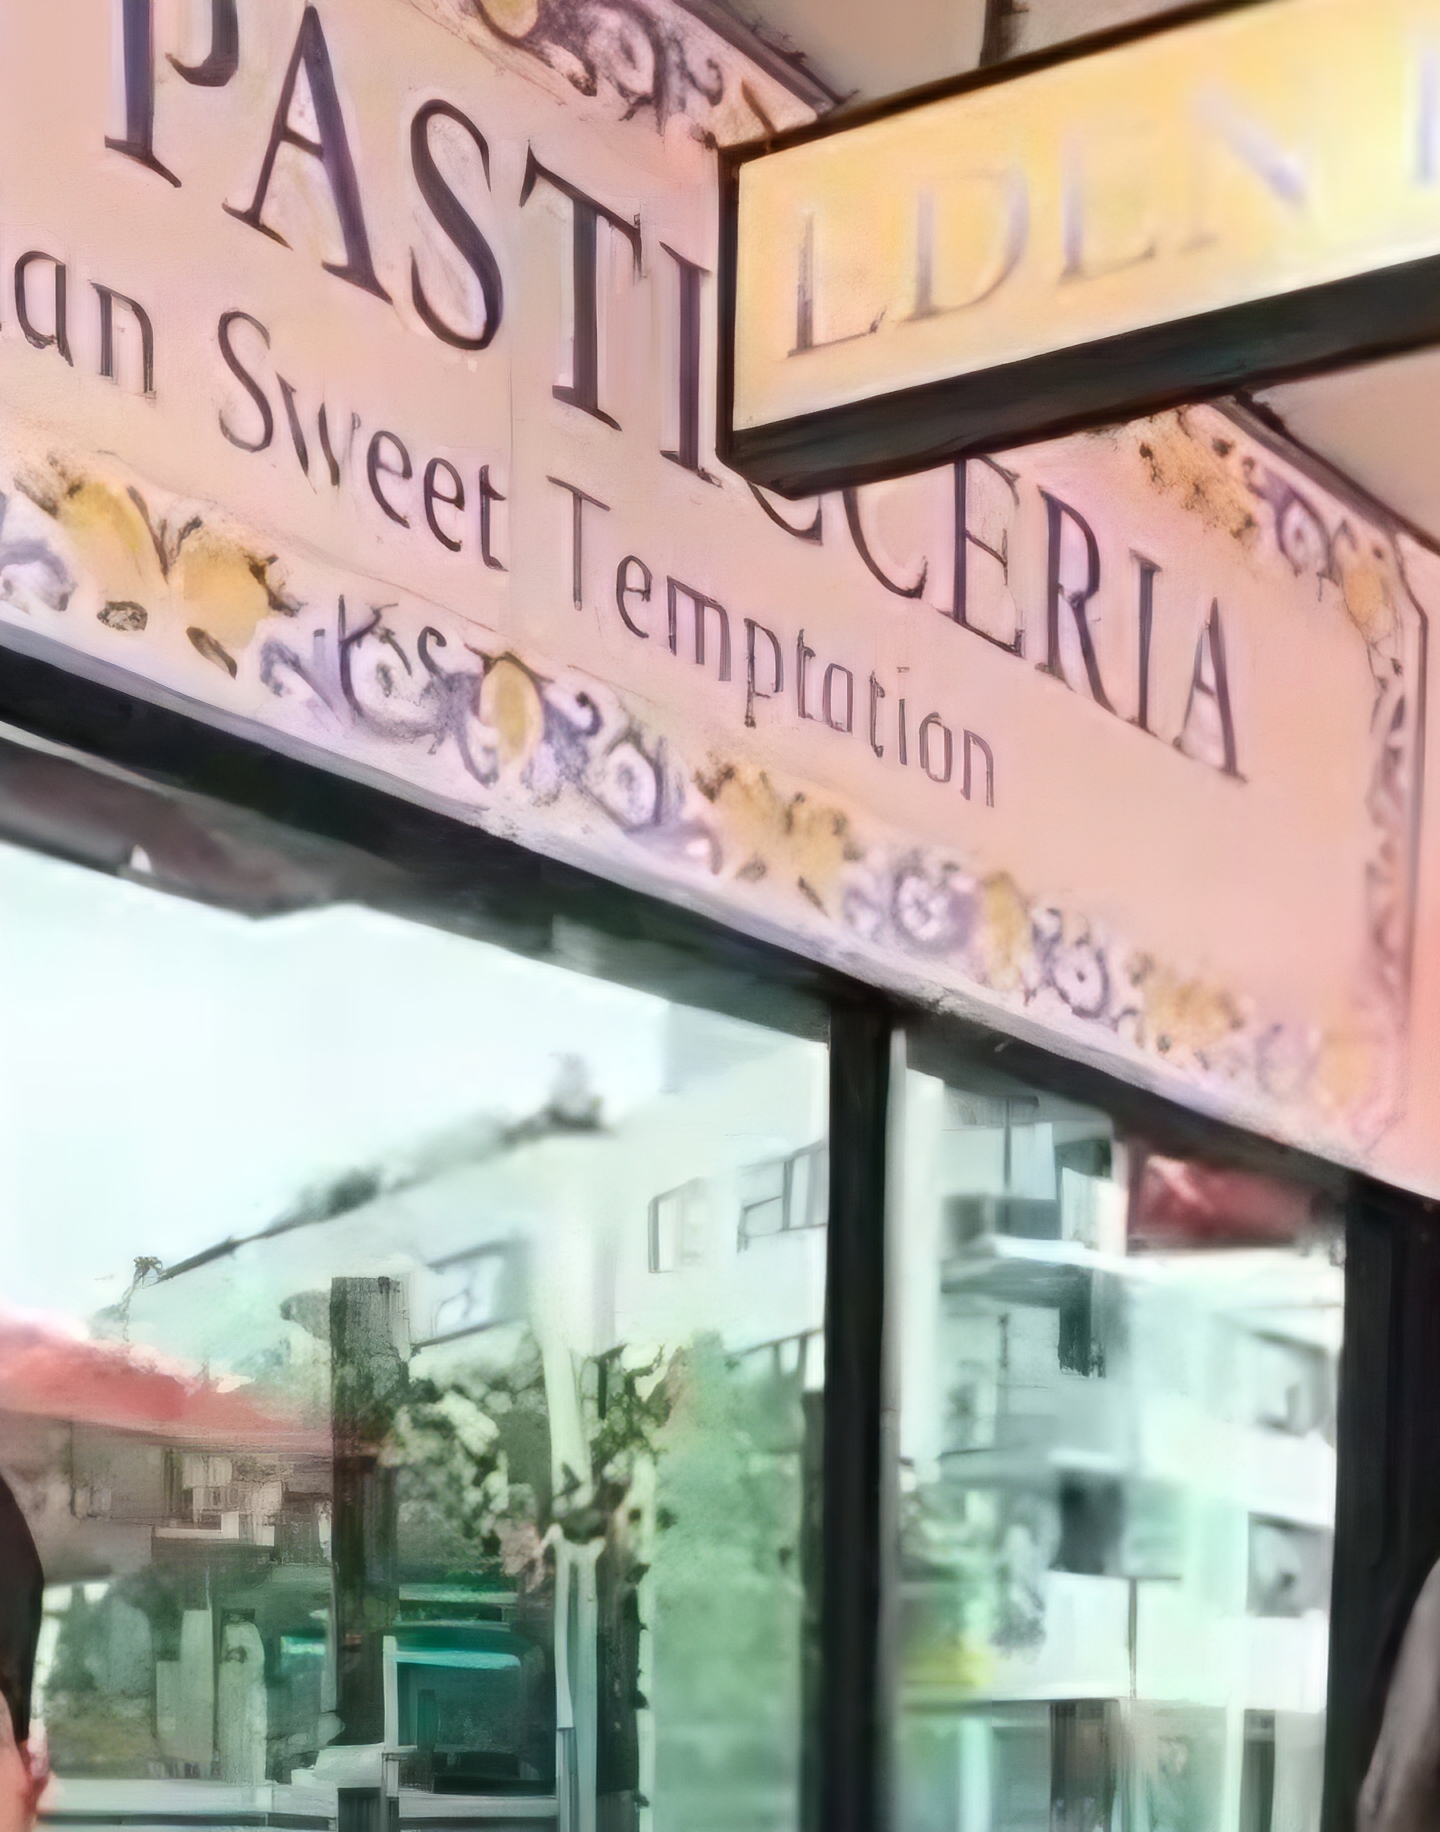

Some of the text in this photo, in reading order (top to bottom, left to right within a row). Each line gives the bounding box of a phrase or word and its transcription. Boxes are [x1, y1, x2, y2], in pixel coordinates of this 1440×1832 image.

[105, 0, 1250, 784] PASTICERIA
[216, 307, 508, 573] Sweet
[546, 473, 996, 808] Temptation
